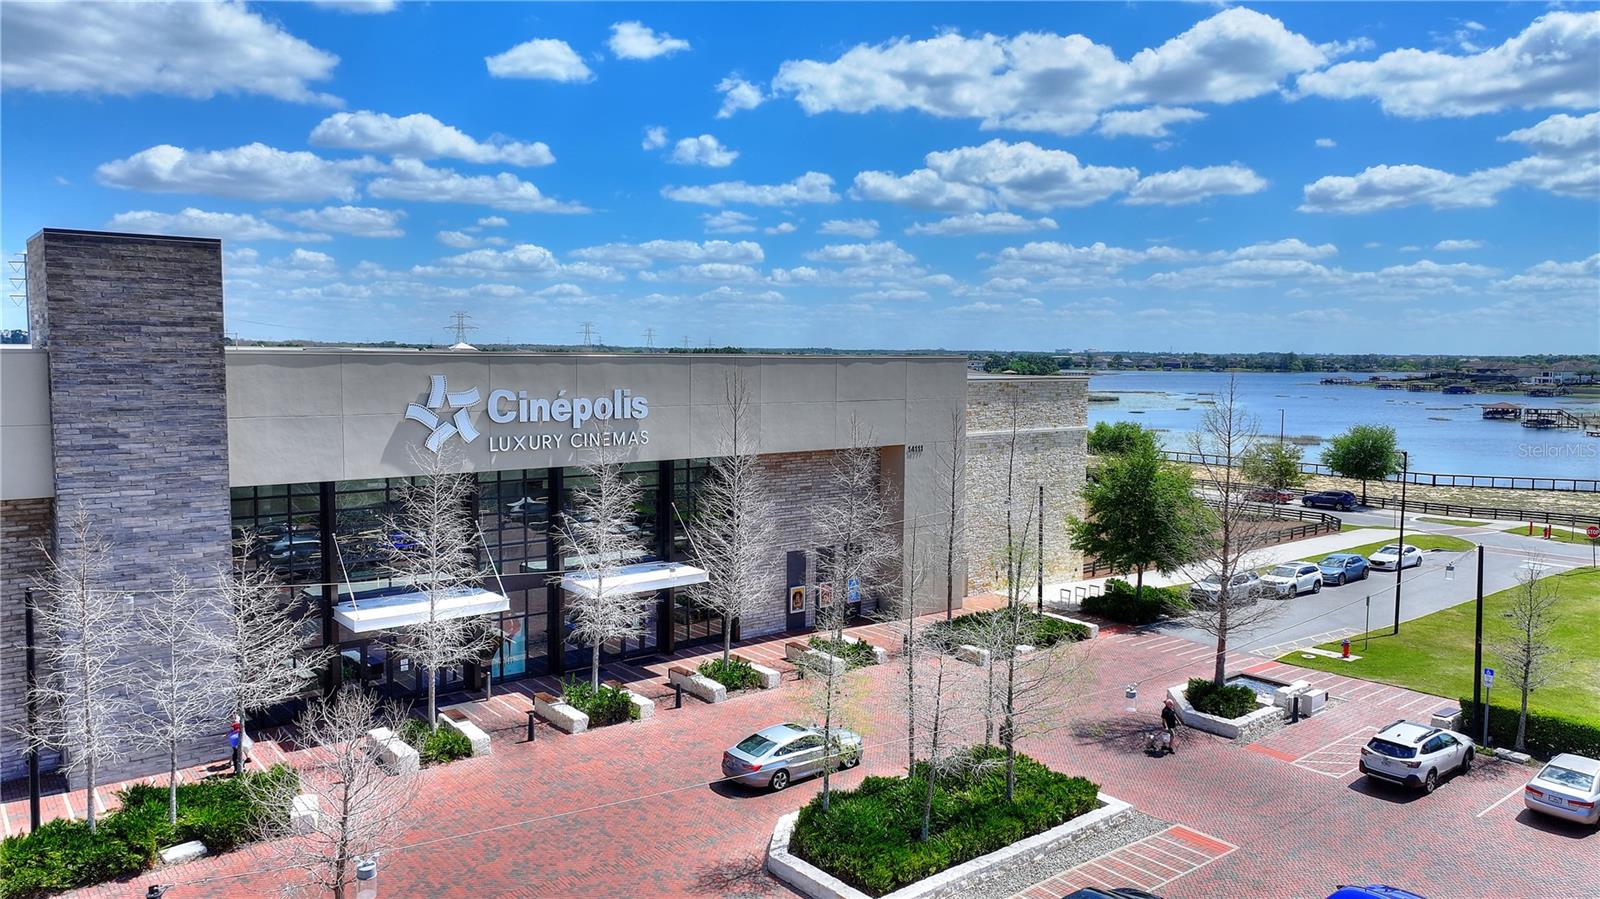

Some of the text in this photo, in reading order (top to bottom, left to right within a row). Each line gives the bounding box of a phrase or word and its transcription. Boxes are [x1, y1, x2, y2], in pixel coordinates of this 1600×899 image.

[487, 388, 649, 429] Cinépolis
[489, 430, 649, 452] LUXURY CINEMAS
